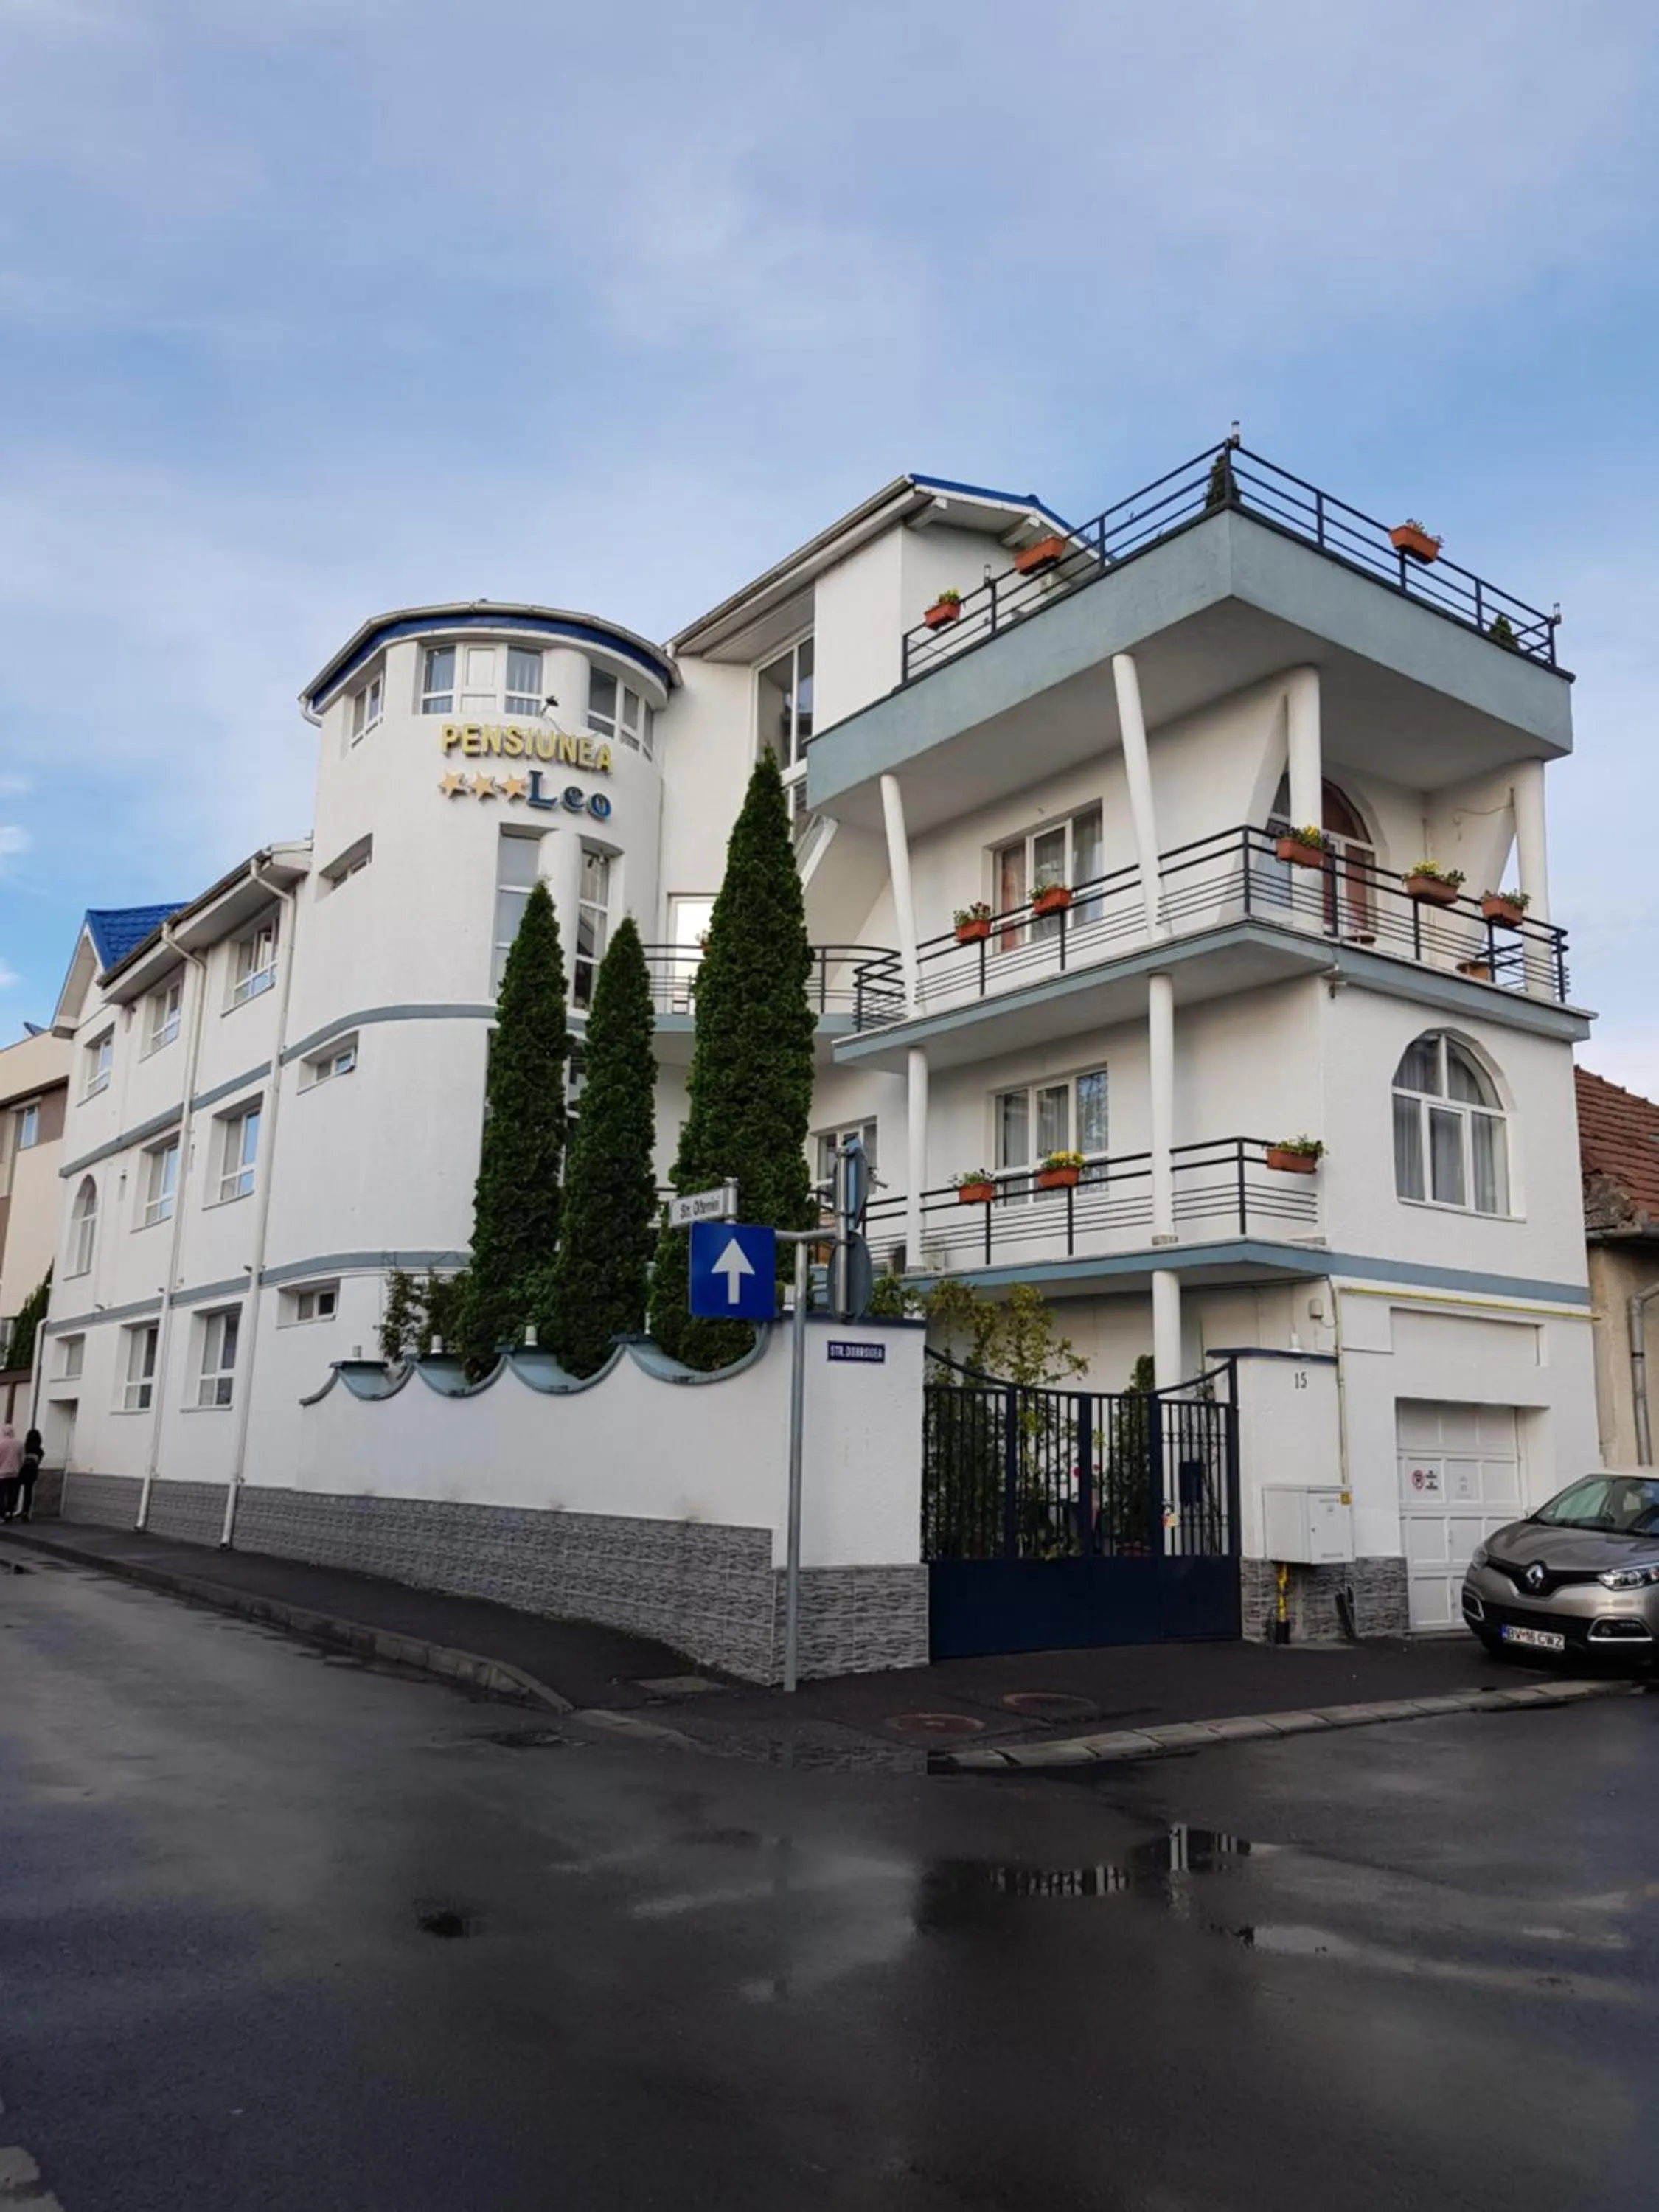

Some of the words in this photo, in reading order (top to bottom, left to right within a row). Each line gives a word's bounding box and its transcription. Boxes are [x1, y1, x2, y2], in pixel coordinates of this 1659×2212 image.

[440, 723, 613, 773] PENSIUNEA
[526, 769, 612, 823] Leo
[1295, 1371, 1307, 1390] 15
